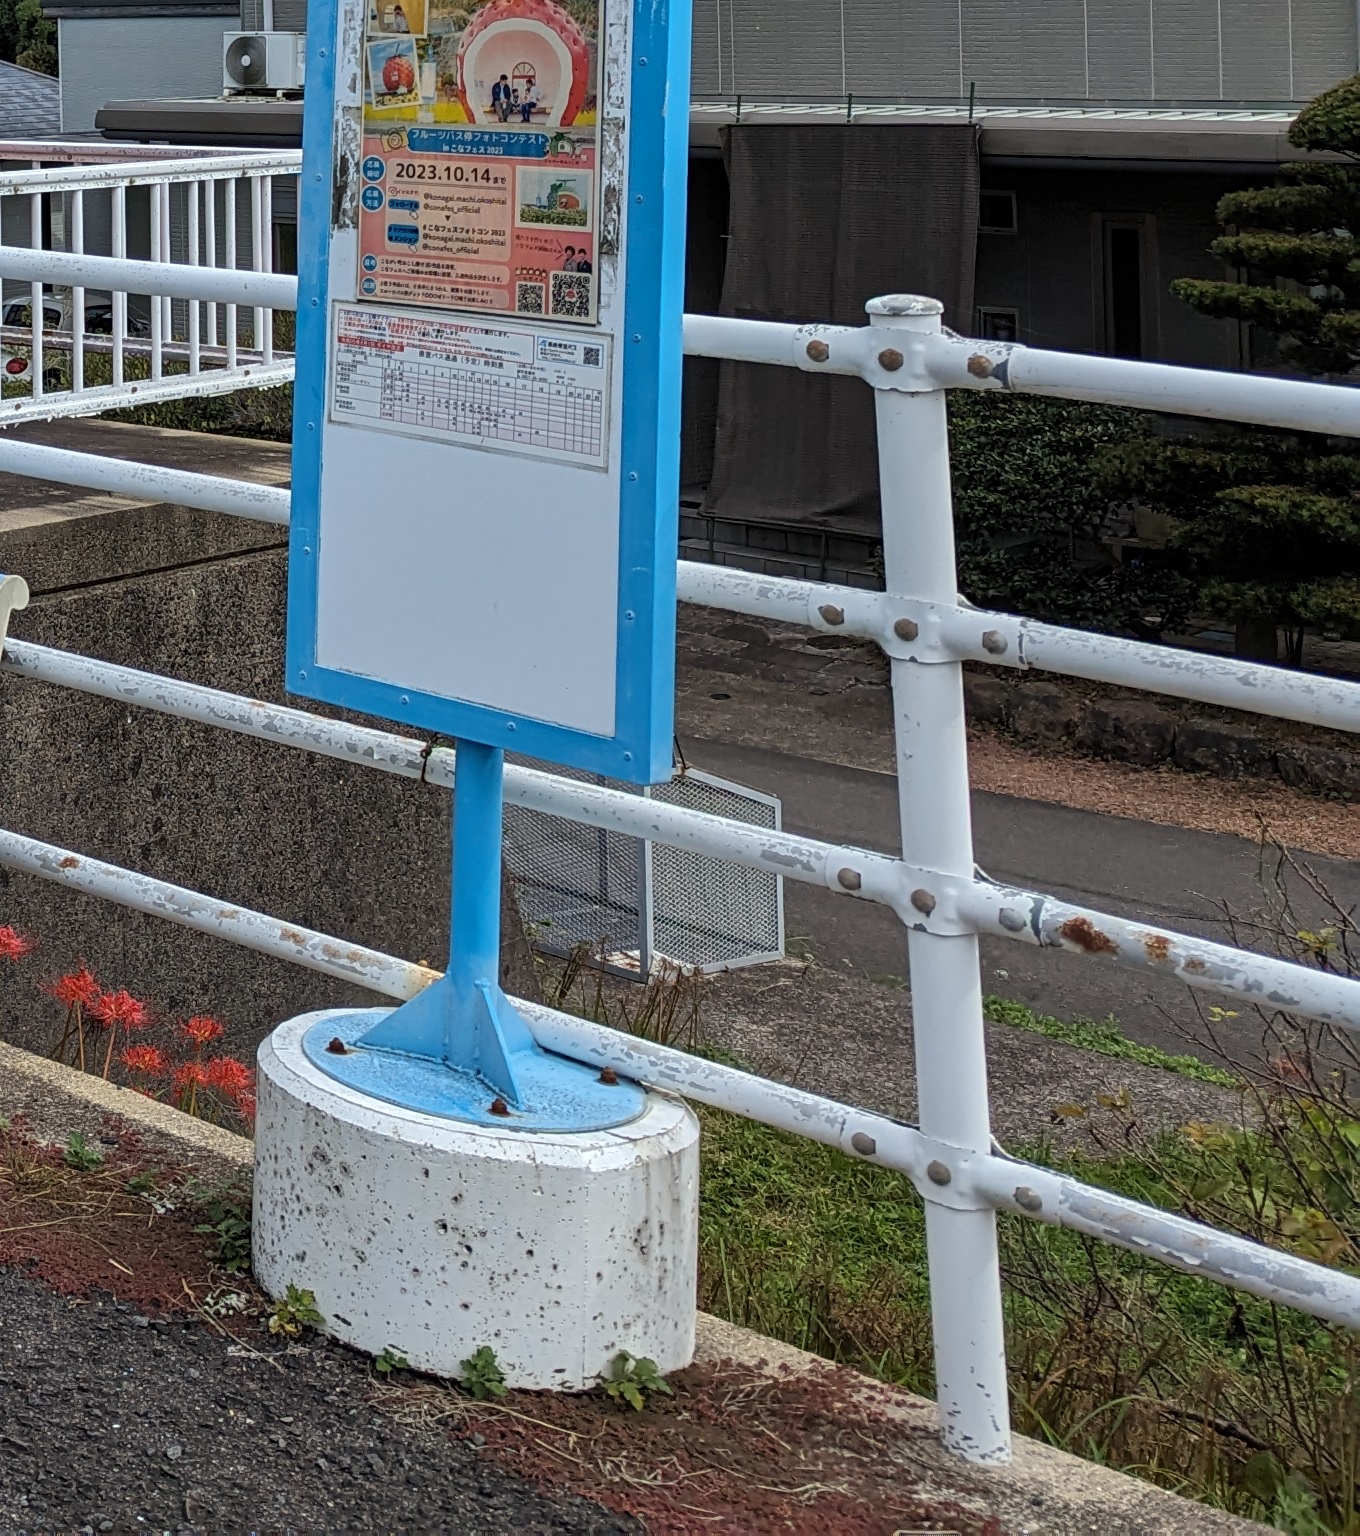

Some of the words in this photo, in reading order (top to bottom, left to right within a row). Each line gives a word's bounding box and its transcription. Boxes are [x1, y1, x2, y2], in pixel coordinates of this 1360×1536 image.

[411, 128, 547, 145] フルーツバス停フォトコンテスト
[486, 146, 504, 155] 2023
